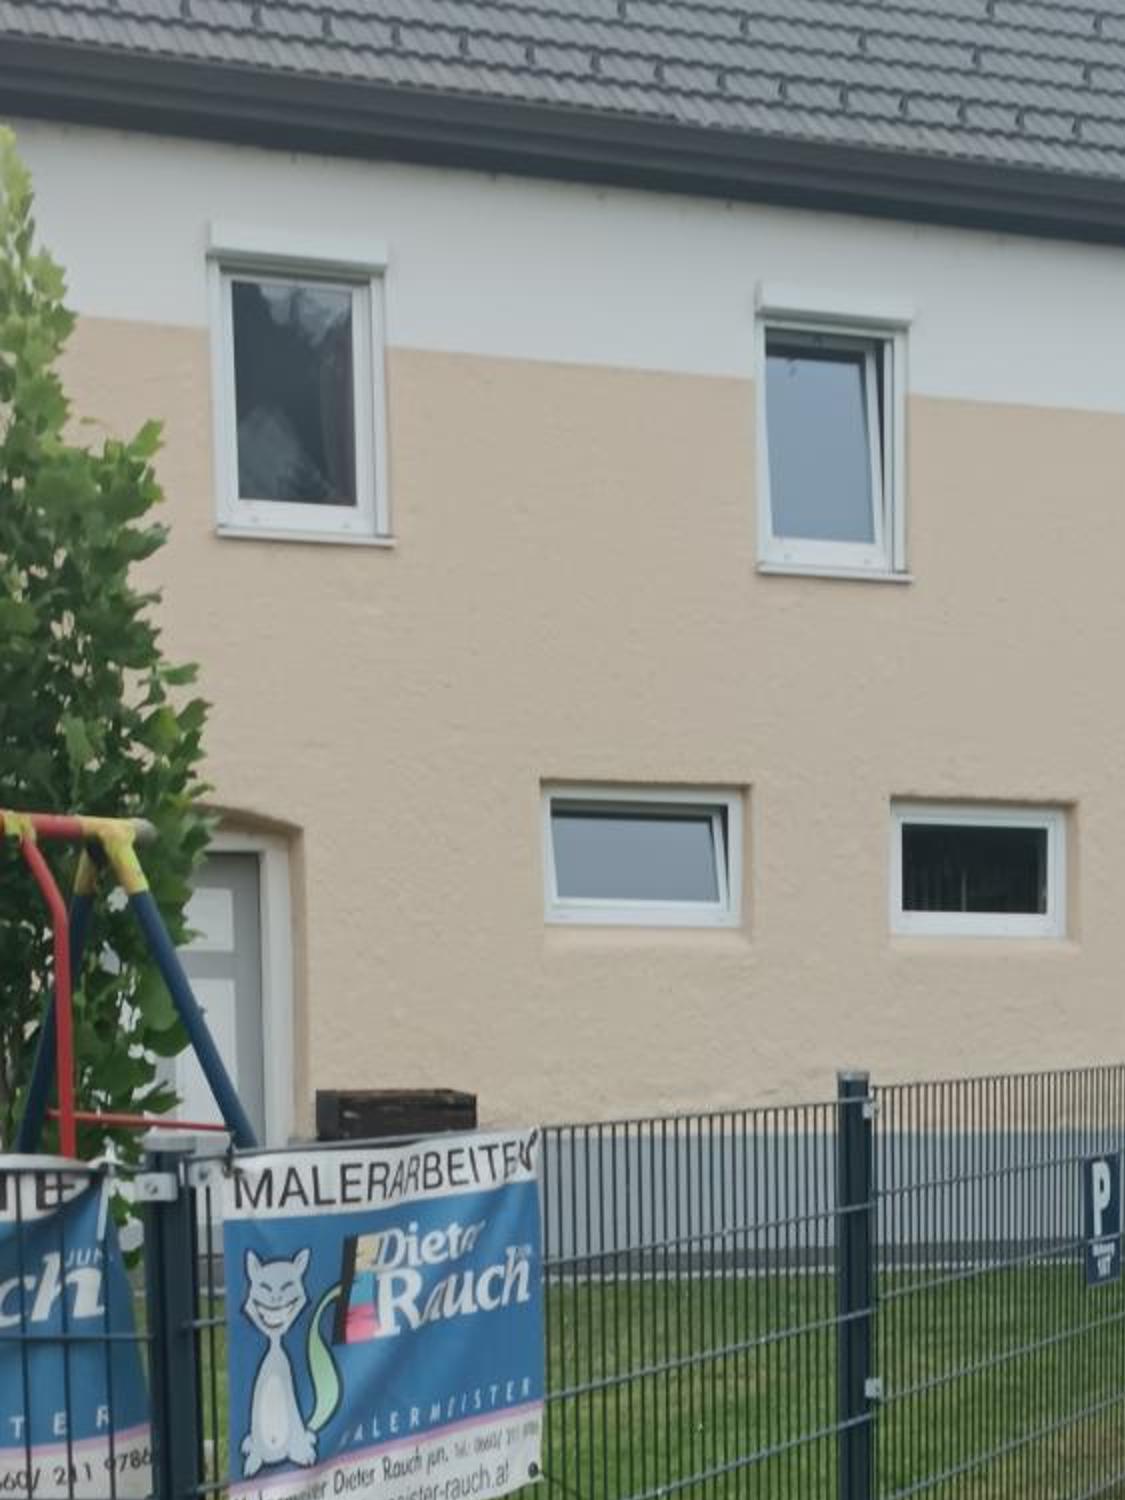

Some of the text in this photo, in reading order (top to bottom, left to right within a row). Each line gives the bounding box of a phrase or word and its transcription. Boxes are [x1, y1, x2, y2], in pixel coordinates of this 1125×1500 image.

[1092, 1161, 1111, 1236] P
[371, 1245, 533, 1338] Rauch
[332, 1466, 376, 1496] Dieter
[382, 1444, 423, 1481] Rauch
